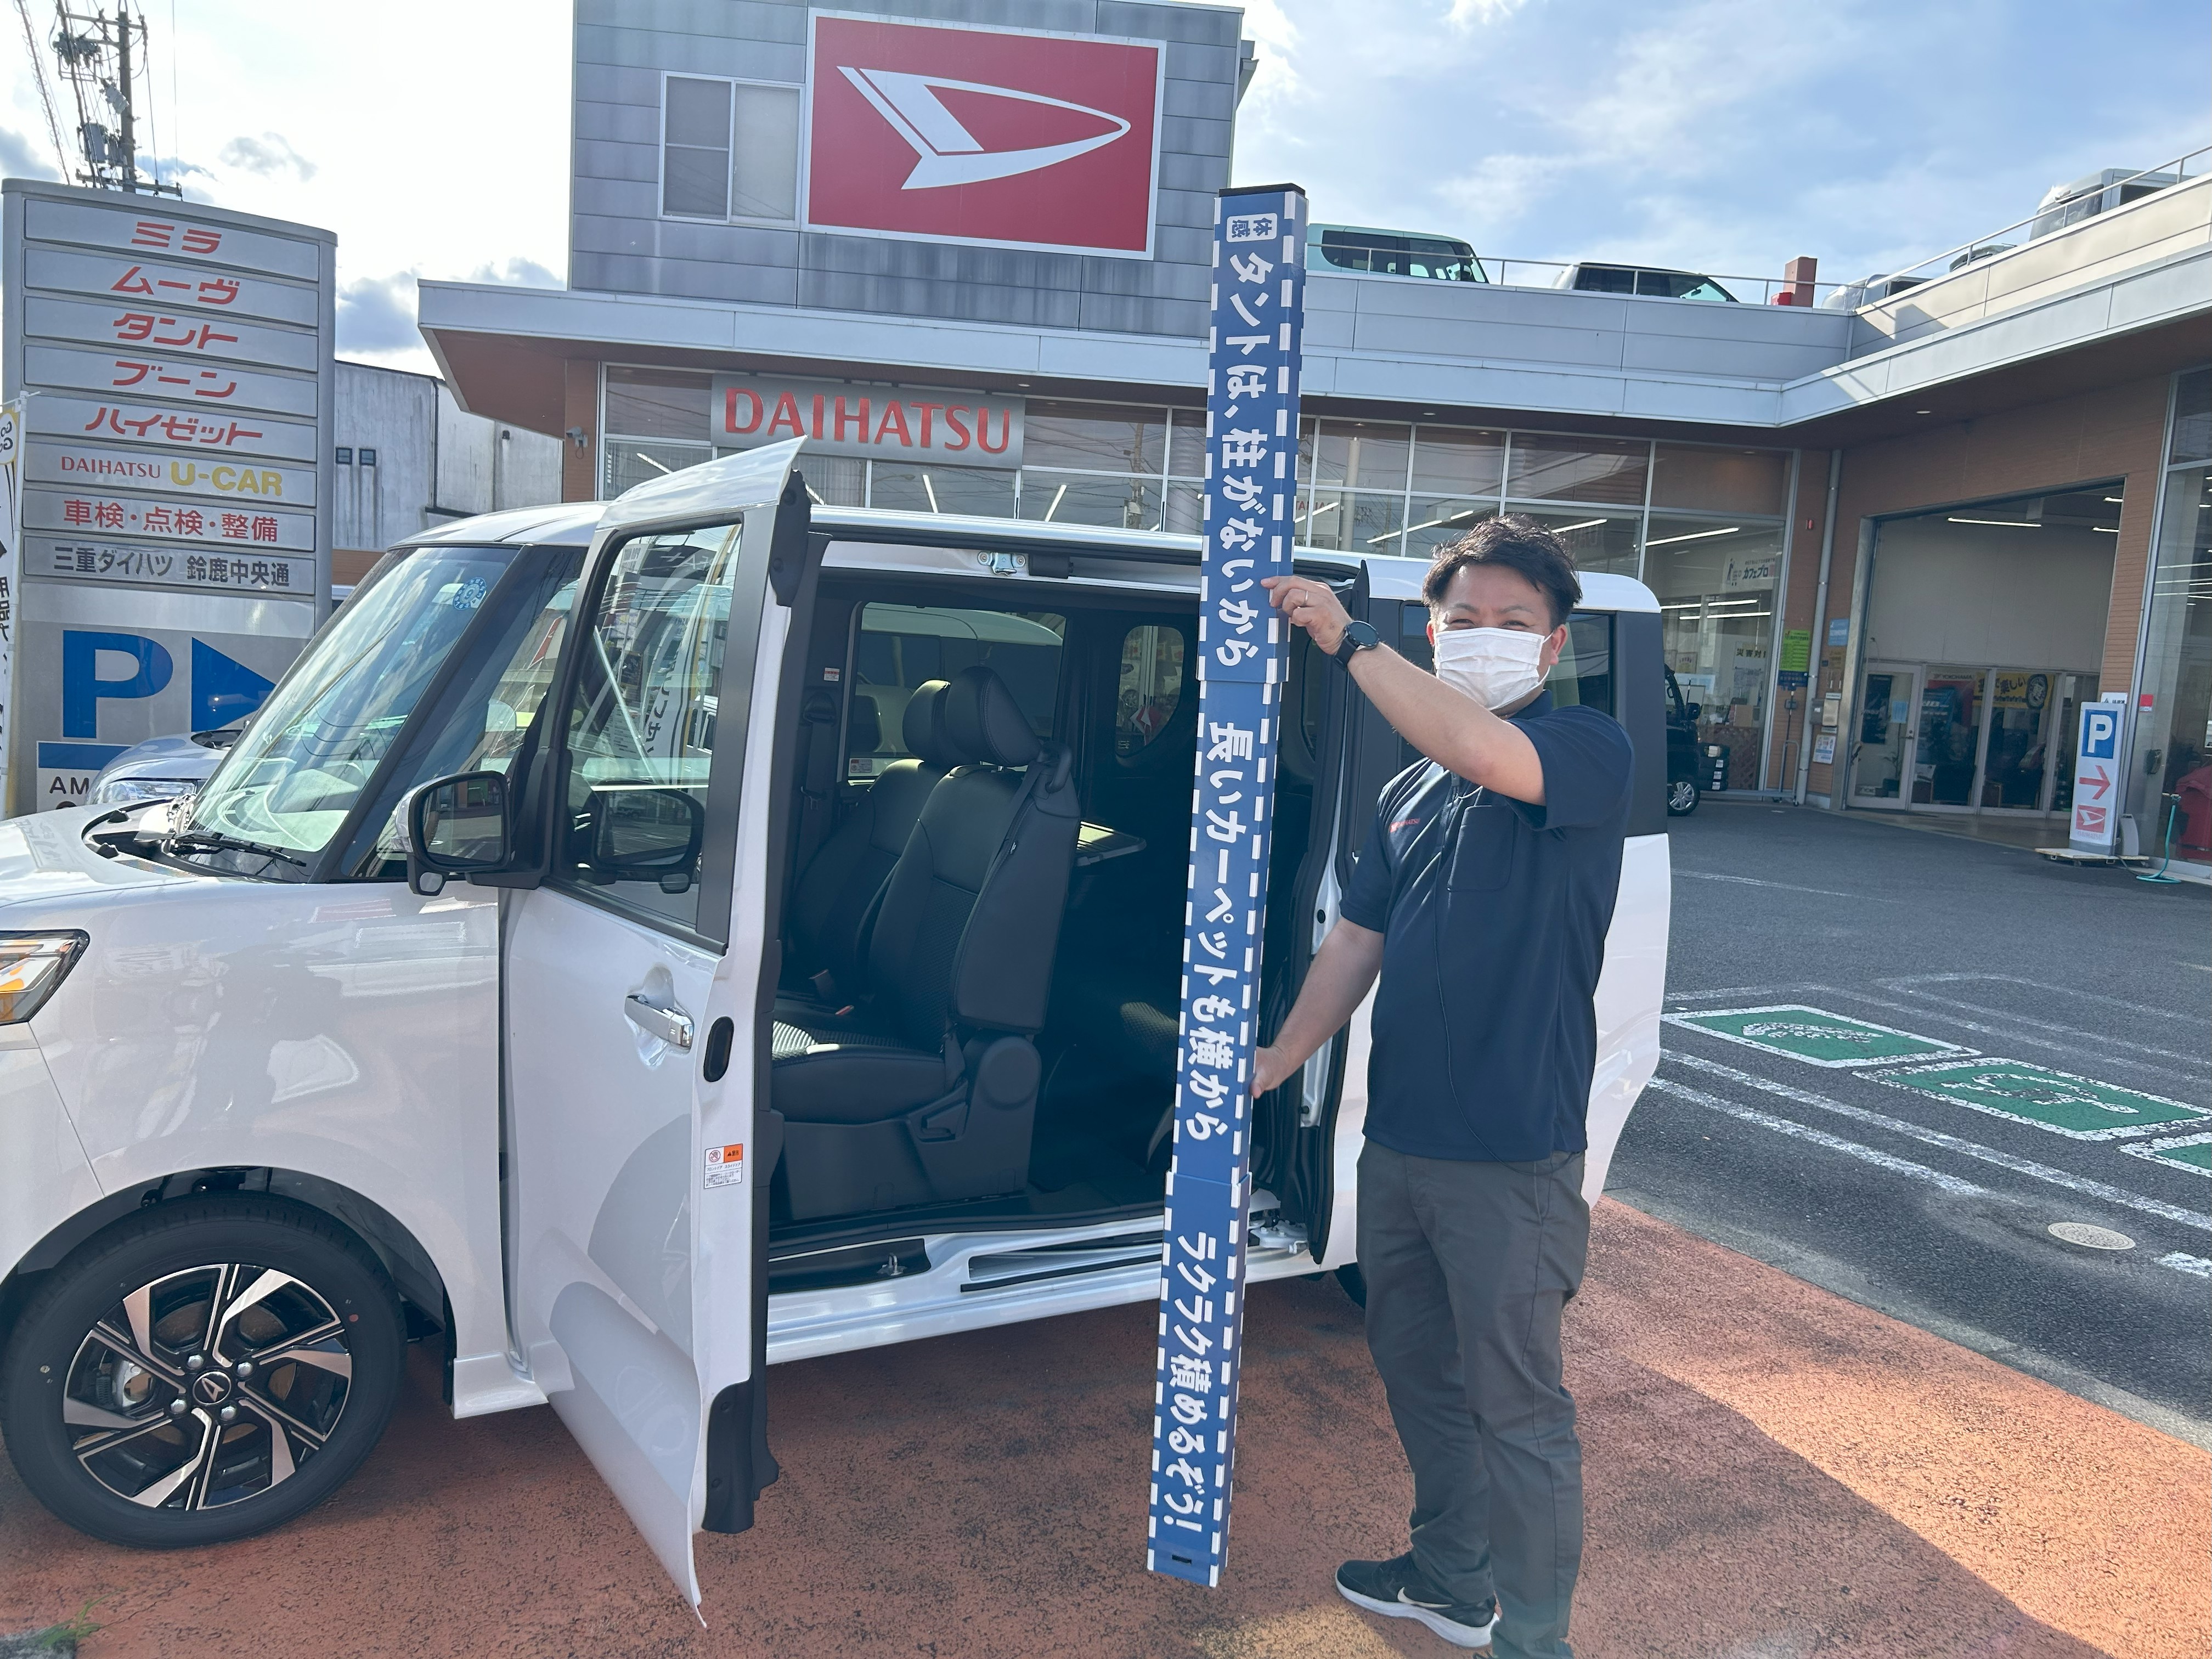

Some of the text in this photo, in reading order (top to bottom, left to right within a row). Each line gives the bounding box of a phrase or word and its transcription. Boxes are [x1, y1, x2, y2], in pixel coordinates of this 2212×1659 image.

[131, 222, 222, 254] ミラ
[1232, 217, 1272, 238] 体感
[111, 267, 240, 305] ムーヴ
[113, 313, 238, 349] タント
[112, 361, 237, 398] ブーン
[84, 407, 263, 446] ハイゼット
[725, 388, 1010, 453] DAIHATSU
[61, 455, 283, 496] DAIHATSU U-CAR
[1216, 252, 1273, 667] タントは、柱がないから
[64, 500, 278, 542] 車検・点検・整備
[54, 548, 290, 587] 三重ダイハツ 鈴鹿中央通
[63, 630, 173, 738] P
[2087, 714, 2113, 753] P
[1186, 721, 1253, 1141] 長いカーペットも横から
